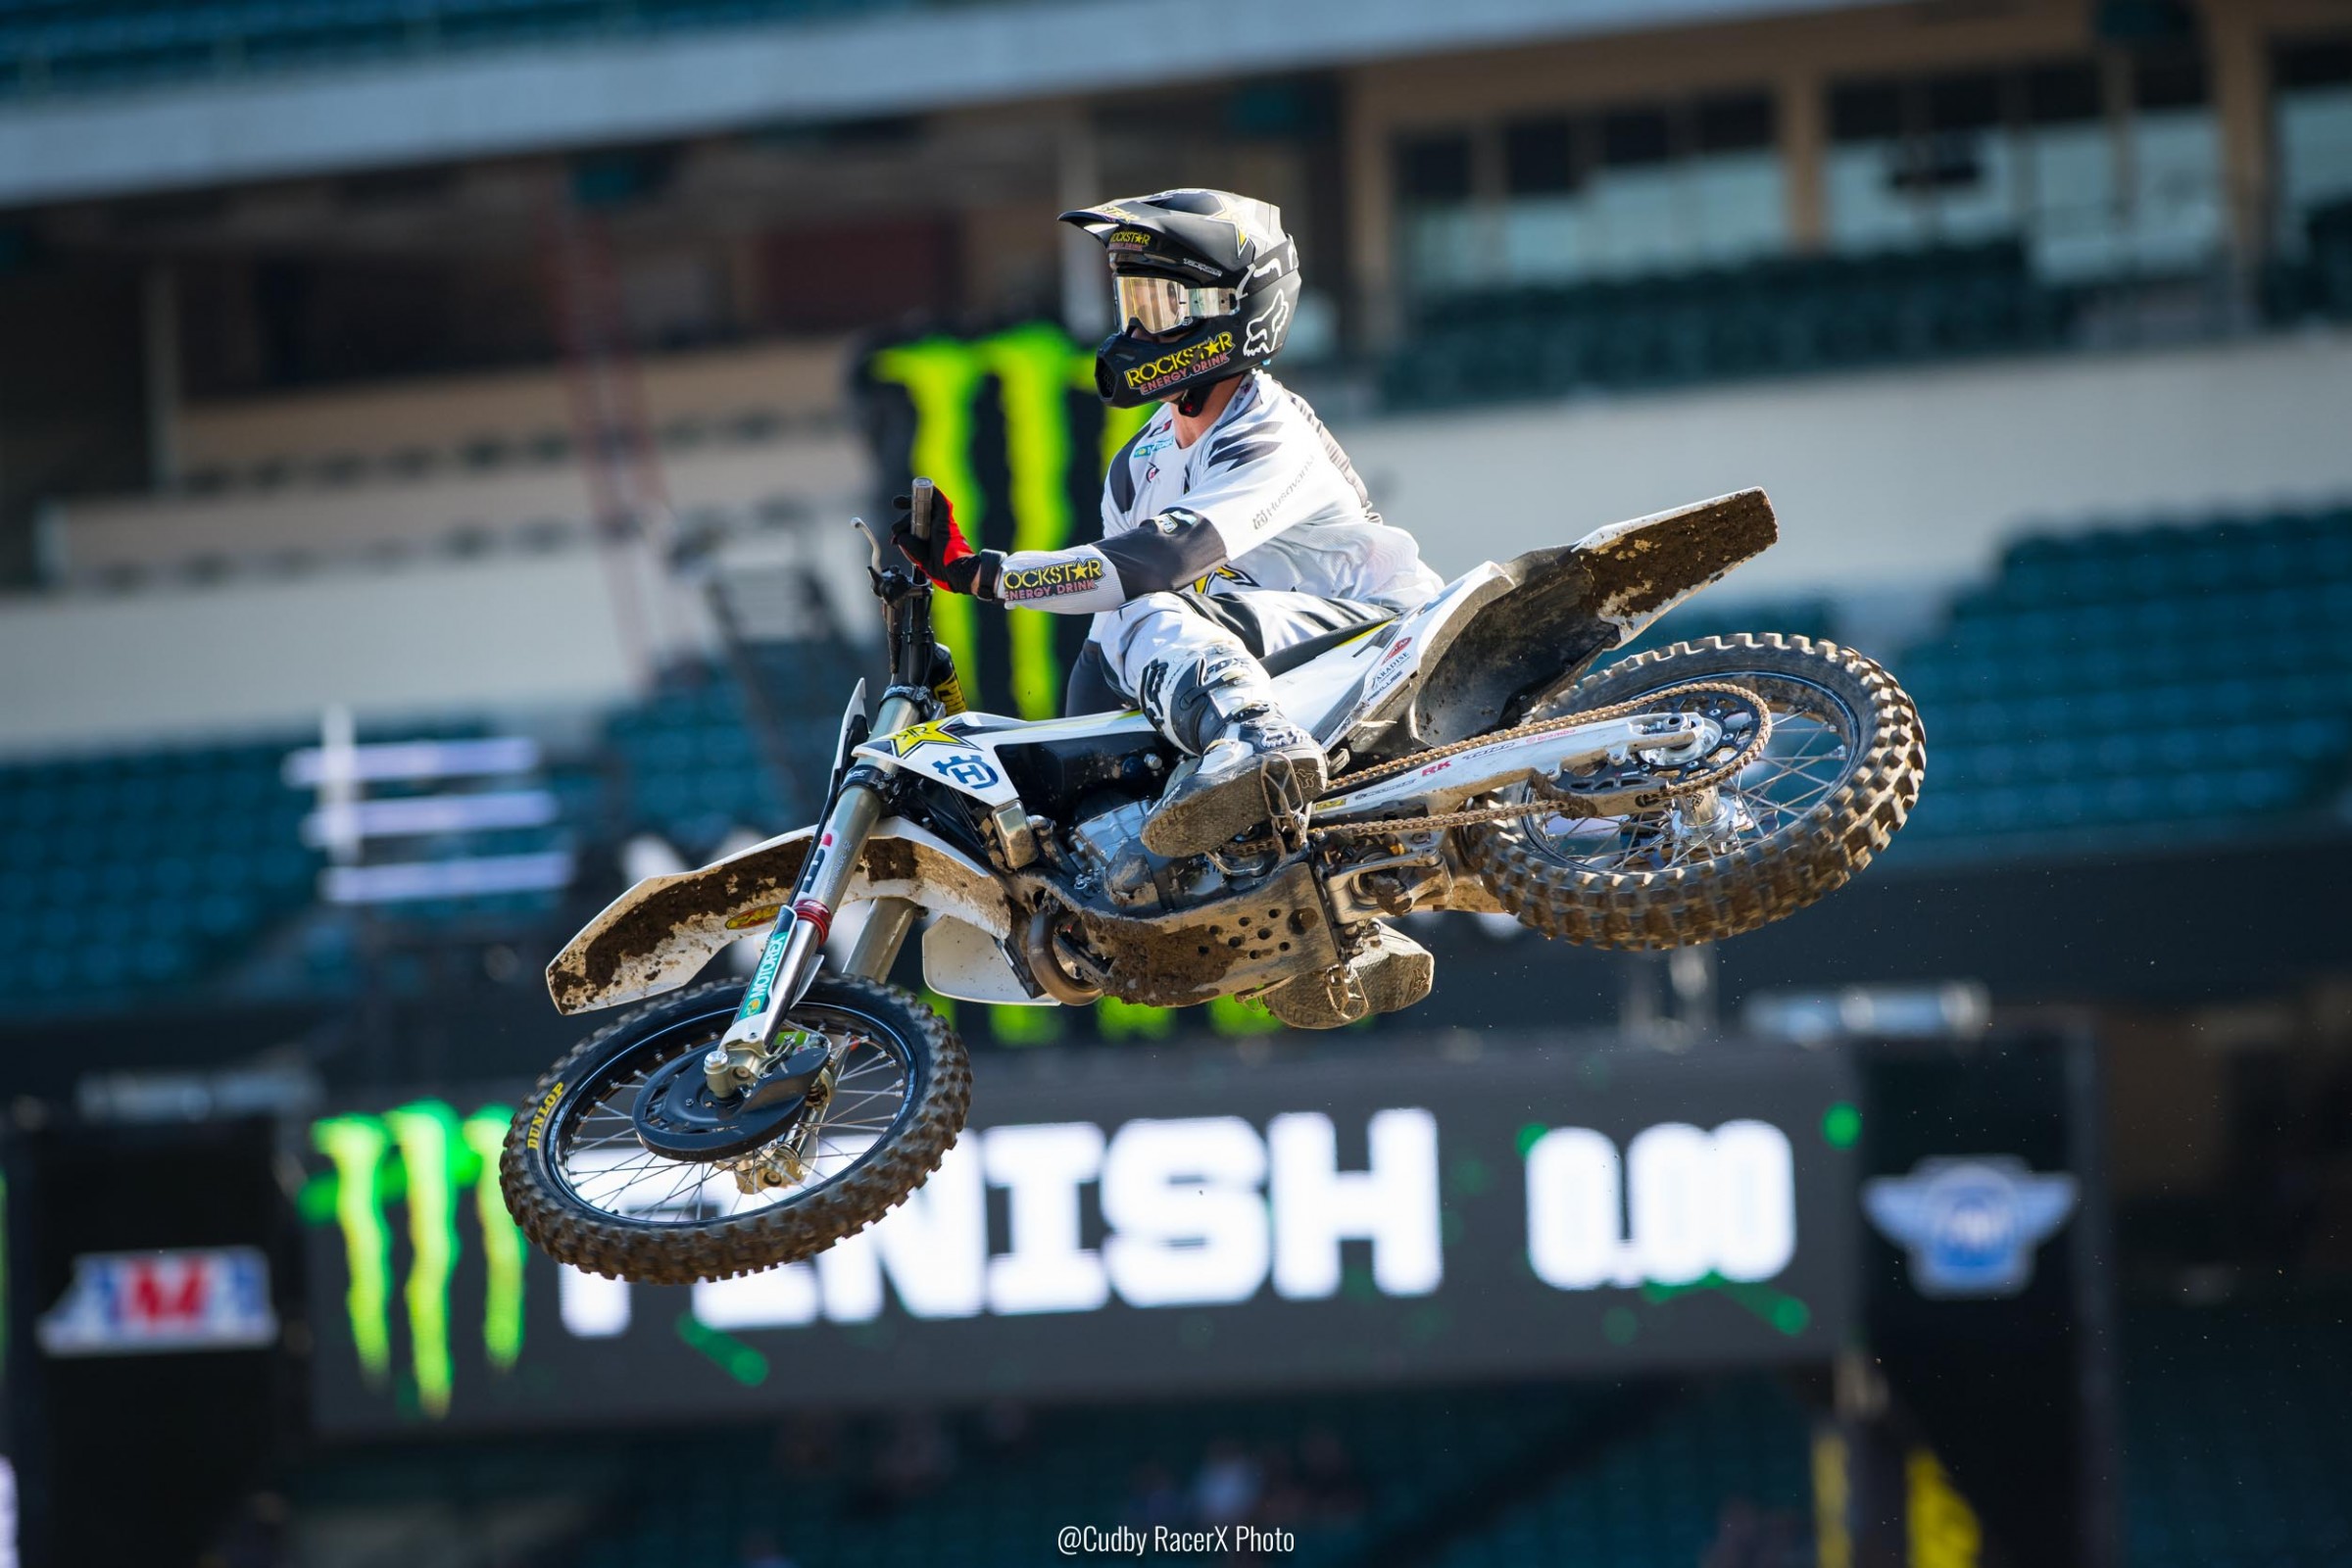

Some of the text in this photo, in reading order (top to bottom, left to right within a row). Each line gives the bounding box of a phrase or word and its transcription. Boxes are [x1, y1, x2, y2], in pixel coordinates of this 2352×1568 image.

[1140, 353, 1229, 392] ENERGY DRINK
[1004, 560, 1102, 589] OCKSTAR
[1004, 579, 1096, 601] ENERGY DRINK
[1421, 760, 1451, 777] RK
[750, 934, 785, 999] MOTOREX
[527, 1081, 564, 1151] DUNLOP
